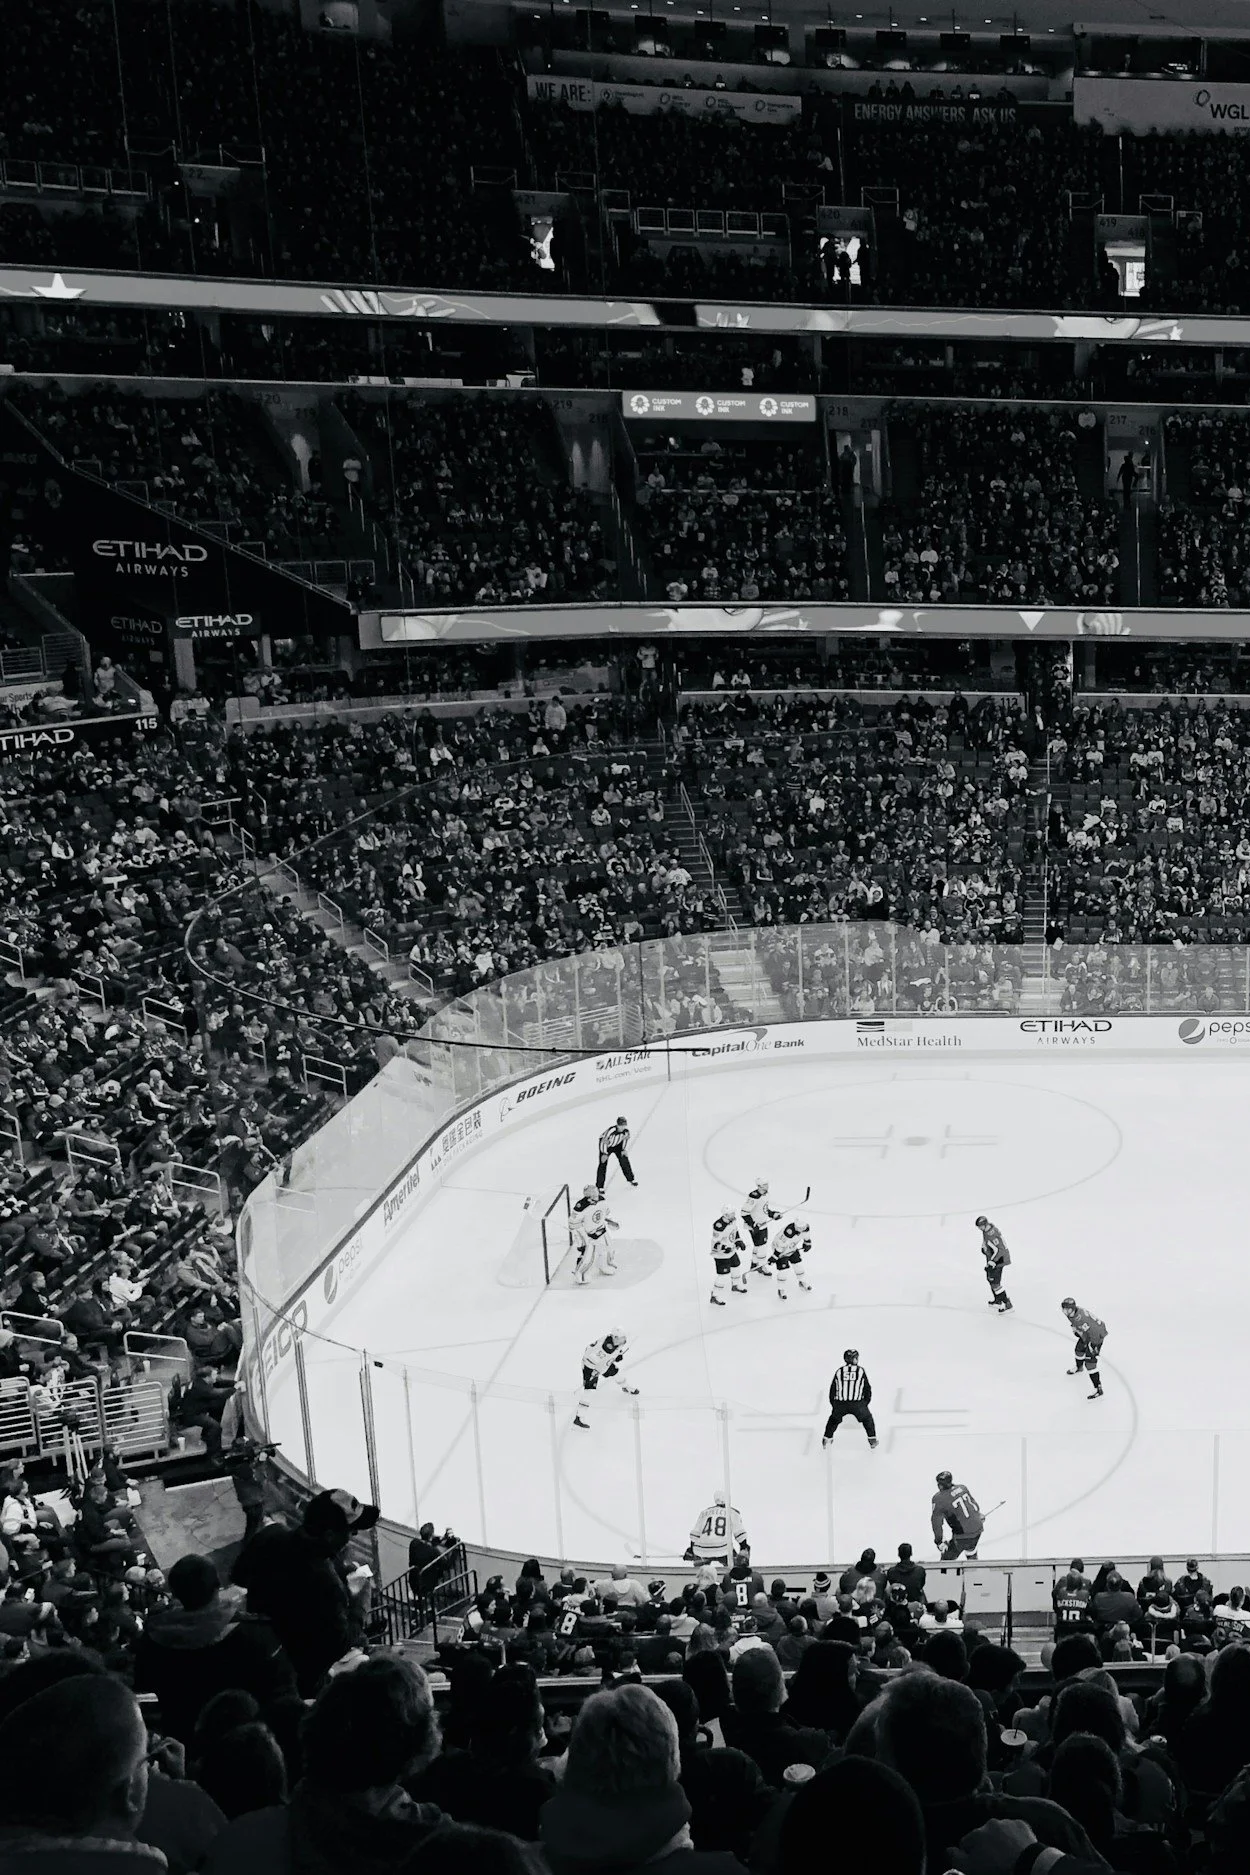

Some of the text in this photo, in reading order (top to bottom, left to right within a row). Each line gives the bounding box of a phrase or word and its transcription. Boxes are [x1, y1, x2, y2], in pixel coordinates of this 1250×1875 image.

[535, 81, 556, 102] WE
[560, 83, 591, 102] ARE:
[854, 103, 901, 121] ENERGY
[972, 107, 996, 124] ASK
[1000, 108, 1017, 124] US
[1210, 104, 1250, 120] WGL
[553, 400, 573, 410] 219
[651, 398, 682, 406] CUSTOM
[828, 406, 849, 416] 218
[1109, 415, 1127, 425] 217
[92, 539, 208, 562] ETIHAD
[115, 562, 189, 578] AIRWAYS
[111, 616, 163, 634] ETIHAD
[175, 613, 254, 629] ETIHAD
[191, 627, 242, 639] AIRWAYS
[134, 717, 158, 731] 115
[1019, 1020, 1113, 1033] ETIHAD
[774, 1038, 805, 1049] Bank
[857, 1035, 963, 1048] MedStar Health
[1037, 1036, 1096, 1045] AIRWAYS
[516, 1072, 577, 1104] BOEING
[338, 1234, 363, 1279] pepsi
[842, 1371, 857, 1382] 50
[701, 1516, 727, 1537] 48
[736, 1583, 748, 1606] 8
[560, 1611, 578, 1635] 8
